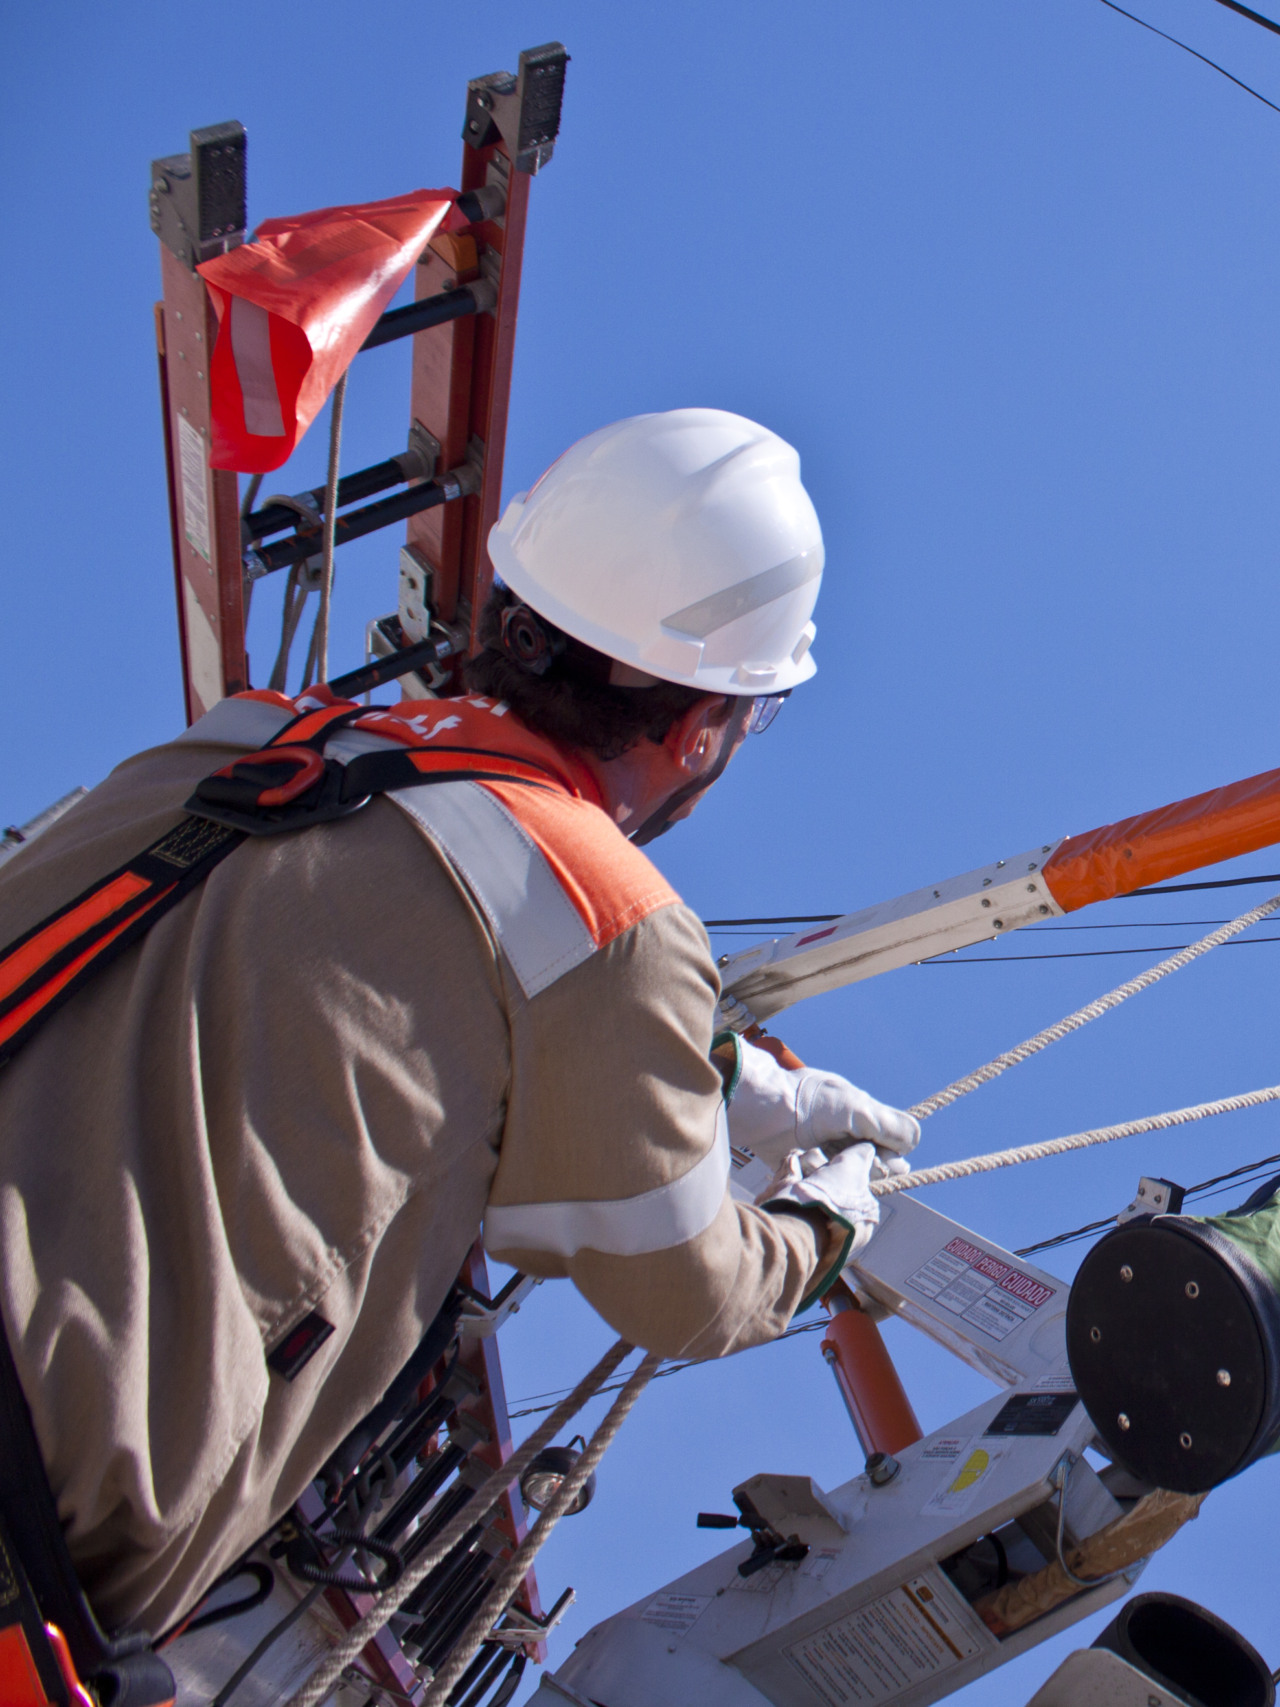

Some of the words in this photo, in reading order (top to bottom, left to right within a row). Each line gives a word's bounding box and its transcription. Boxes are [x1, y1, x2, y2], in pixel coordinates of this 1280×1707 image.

[944, 1238, 982, 1264] CUIDADO
[974, 1256, 1008, 1280] PERIGO
[1000, 1271, 1051, 1306] CUIDADO
